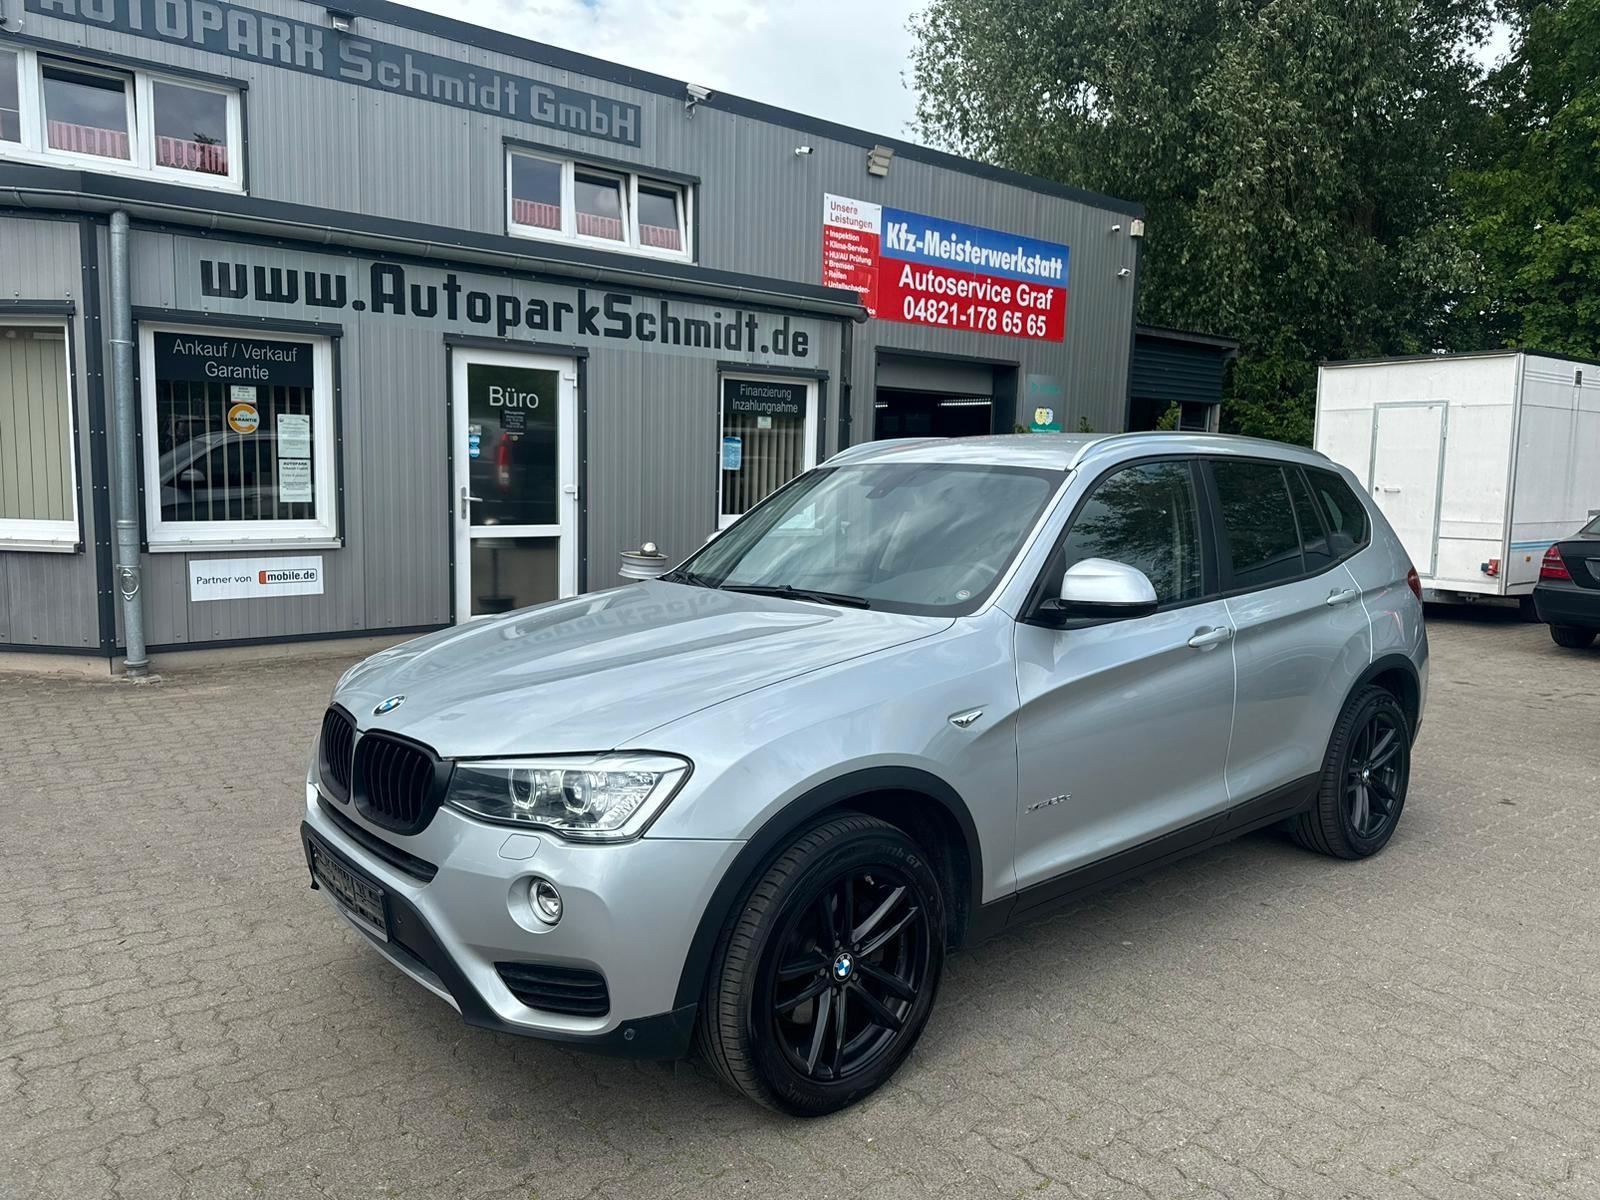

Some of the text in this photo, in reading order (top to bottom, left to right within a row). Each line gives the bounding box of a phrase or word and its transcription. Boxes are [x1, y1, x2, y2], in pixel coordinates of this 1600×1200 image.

[40, 0, 636, 142] TOPARK Schmidt GmbH
[830, 201, 858, 215] Unsere
[830, 212, 873, 229] Leistungen
[829, 229, 860, 242] Inspektion
[829, 240, 869, 254] Klima-Service
[886, 222, 1063, 280] Kfz-Meisterwerkstatt
[828, 260, 855, 271] Bremsen
[828, 269, 847, 280] Reifen
[898, 264, 1053, 310] Autoservice Graf
[200, 261, 809, 357] www.AutoparkSchmidt.de
[903, 295, 1046, 337] 04821-178 65 65
[173, 339, 298, 363] Ankauf / Verkauf
[204, 361, 269, 380] Garantie
[489, 385, 539, 409] Büro
[740, 383, 792, 401] Finanzierung
[732, 398, 799, 415] Inzahlungnahme
[196, 575, 232, 585] Partner
[267, 569, 316, 582] mobile.de
